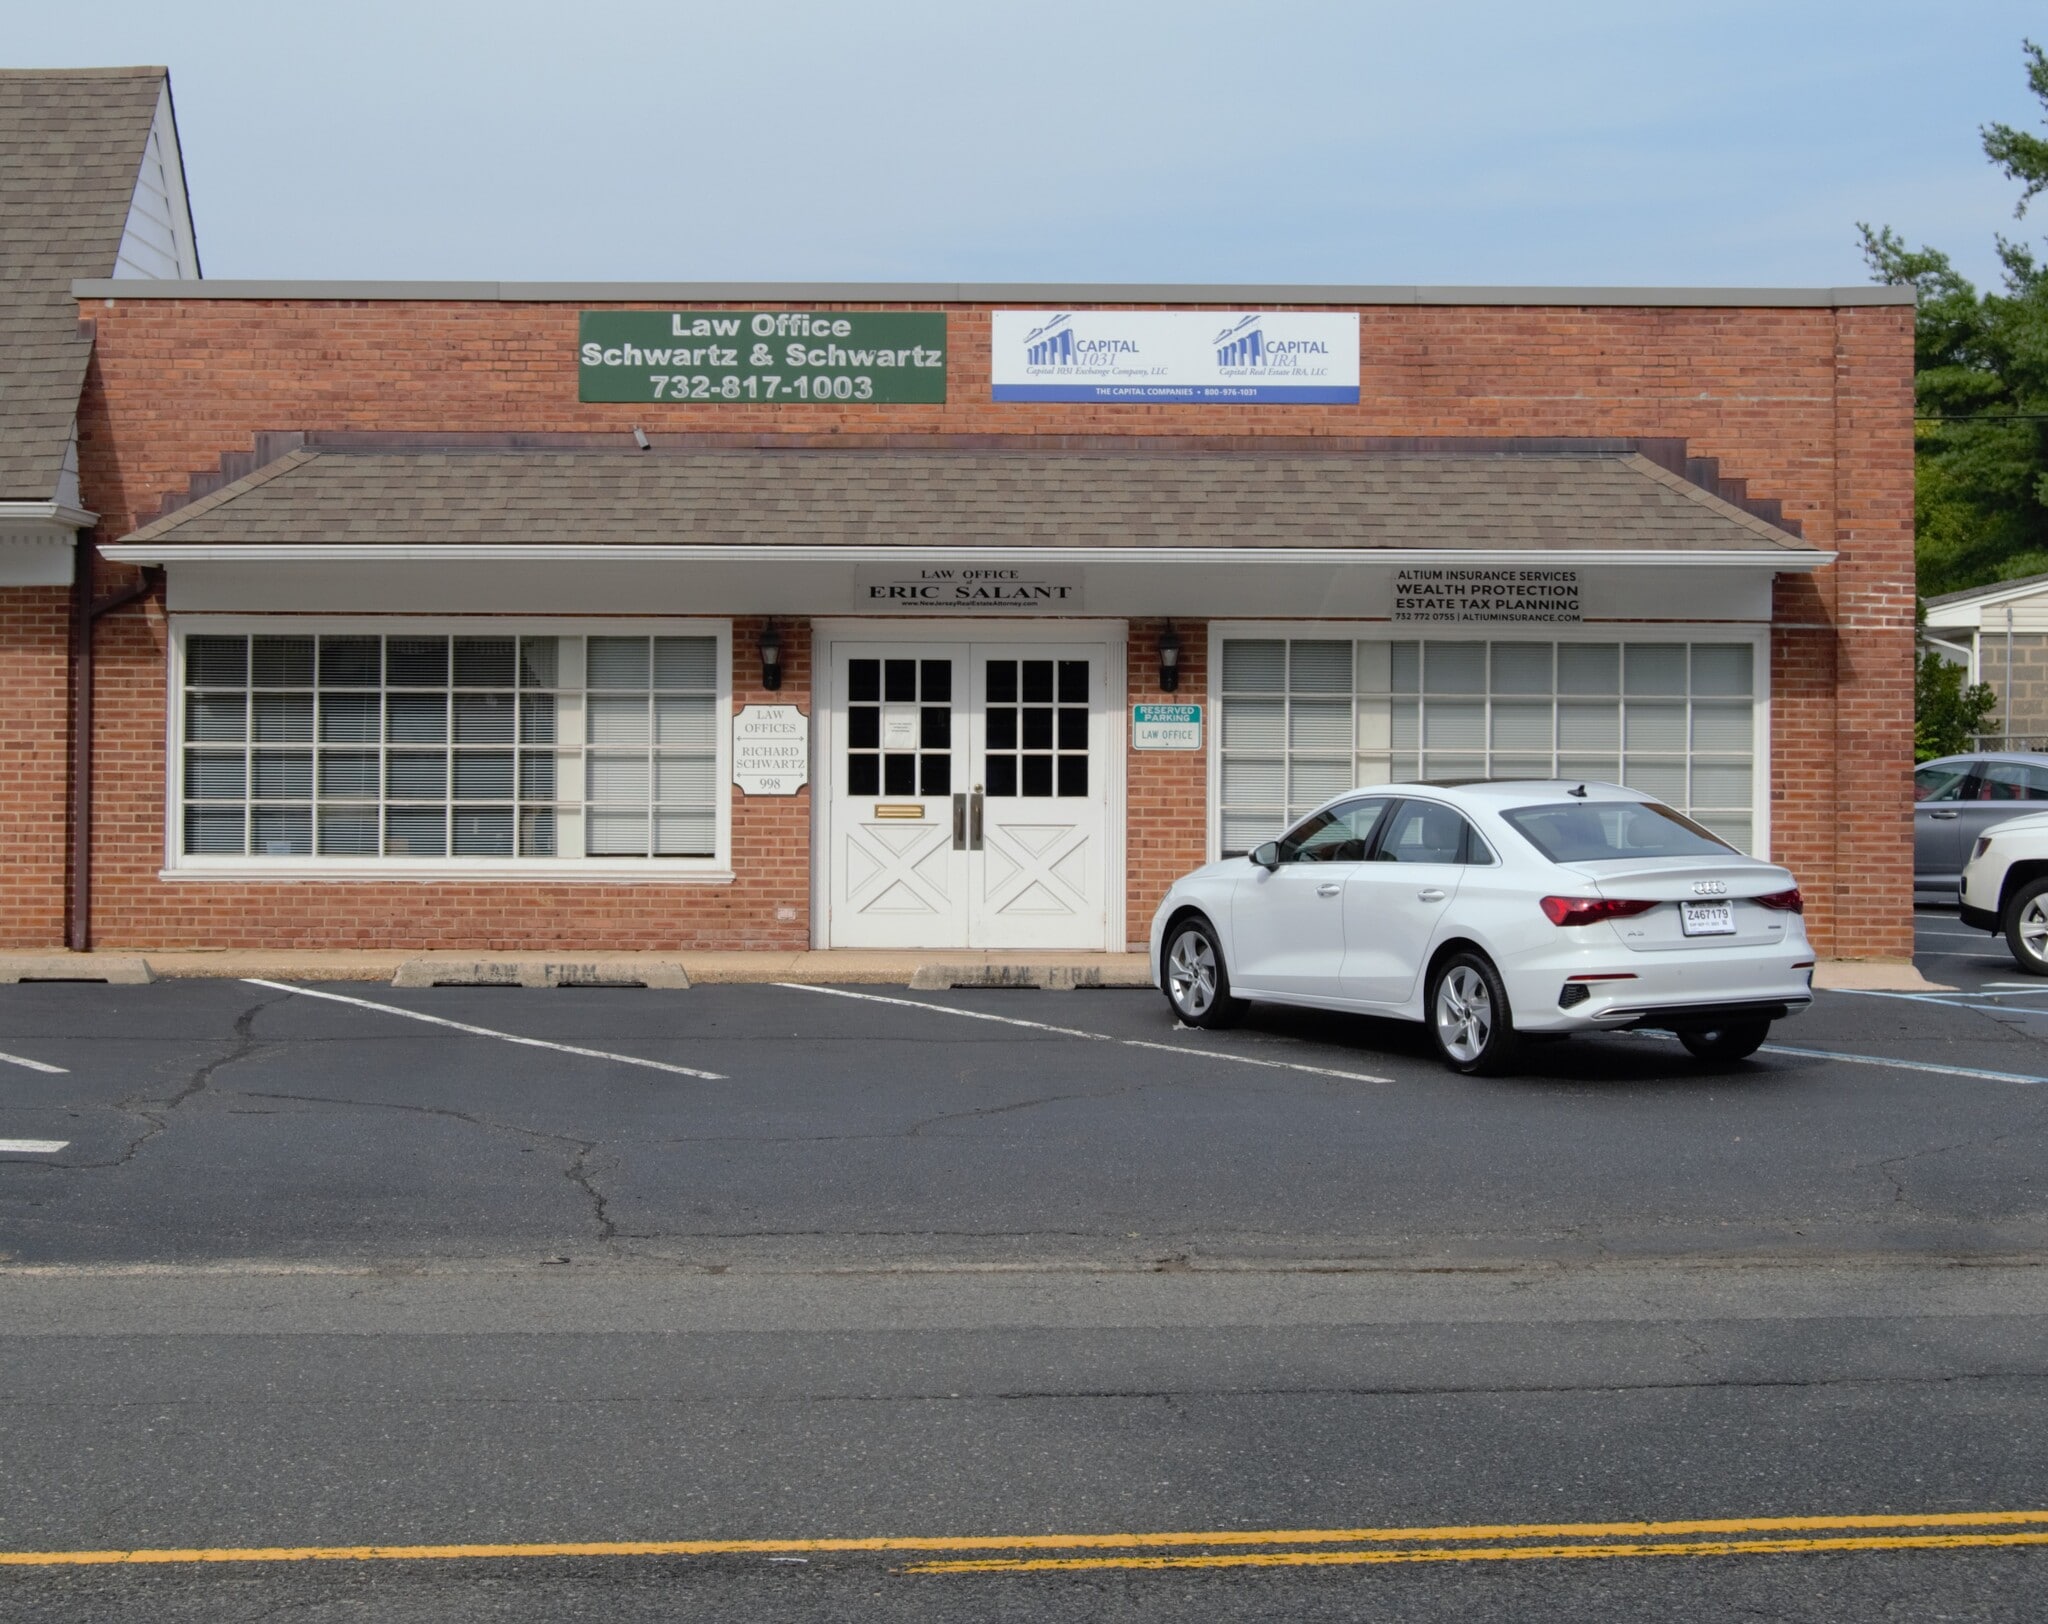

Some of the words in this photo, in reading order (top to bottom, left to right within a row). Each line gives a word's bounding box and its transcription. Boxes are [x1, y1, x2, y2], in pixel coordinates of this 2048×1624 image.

[672, 314, 741, 336] Law
[752, 313, 852, 337] Office
[1076, 340, 1139, 353] CAPITAL
[1266, 341, 1329, 353] CAPITAL
[581, 343, 738, 366] Schwartz
[749, 343, 774, 366] &
[785, 344, 942, 367] Schwartz
[1081, 353, 1116, 366] 1031
[1271, 354, 1298, 367] IRA
[1026, 366, 1054, 377] Capital
[1056, 367, 1073, 375] 1031
[1075, 366, 1110, 377] Exchange
[1112, 367, 1149, 377] Company,
[1151, 367, 1168, 375] LLC
[1219, 367, 1248, 378] Capital
[1250, 367, 1266, 376] Real
[1268, 367, 1290, 376] Estate
[1311, 367, 1328, 376] LLC
[650, 375, 873, 399] 732-817-1003
[1112, 388, 1146, 396] CAPITAL
[1147, 388, 1193, 396] COMPANIES
[1204, 388, 1257, 396] 800-976-1031
[921, 570, 954, 579] LAW
[962, 570, 1019, 579] OFFICE
[1398, 570, 1443, 580] ALTIUM
[1446, 571, 1516, 581] INSURANCE
[1519, 572, 1577, 582] SERVICES
[869, 586, 940, 599] ERIC
[955, 586, 1072, 599] SALANT
[1396, 584, 1466, 595] WEALTH
[1471, 585, 1579, 596] PROTECTION
[1396, 598, 1455, 609] ESTATE
[1460, 599, 1491, 609] TAX
[1495, 600, 1579, 610] PLANNING
[1432, 613, 1455, 621] 0755
[1462, 613, 1581, 622] ALTIUMINSURANCE.COM
[757, 710, 784, 719] LAW
[1140, 706, 1195, 714] RESERVED
[1144, 714, 1191, 722] PARKING
[745, 723, 796, 733] OFFICES
[1142, 730, 1159, 739] LAW
[1162, 730, 1193, 739] OFFICE
[742, 747, 799, 756] RICHARD
[736, 759, 805, 768] SCHWARTZ
[760, 778, 781, 789] 998
[1687, 908, 1729, 920] Z467179
[544, 963, 597, 980] FIRM
[1048, 965, 1100, 984] FIRM
